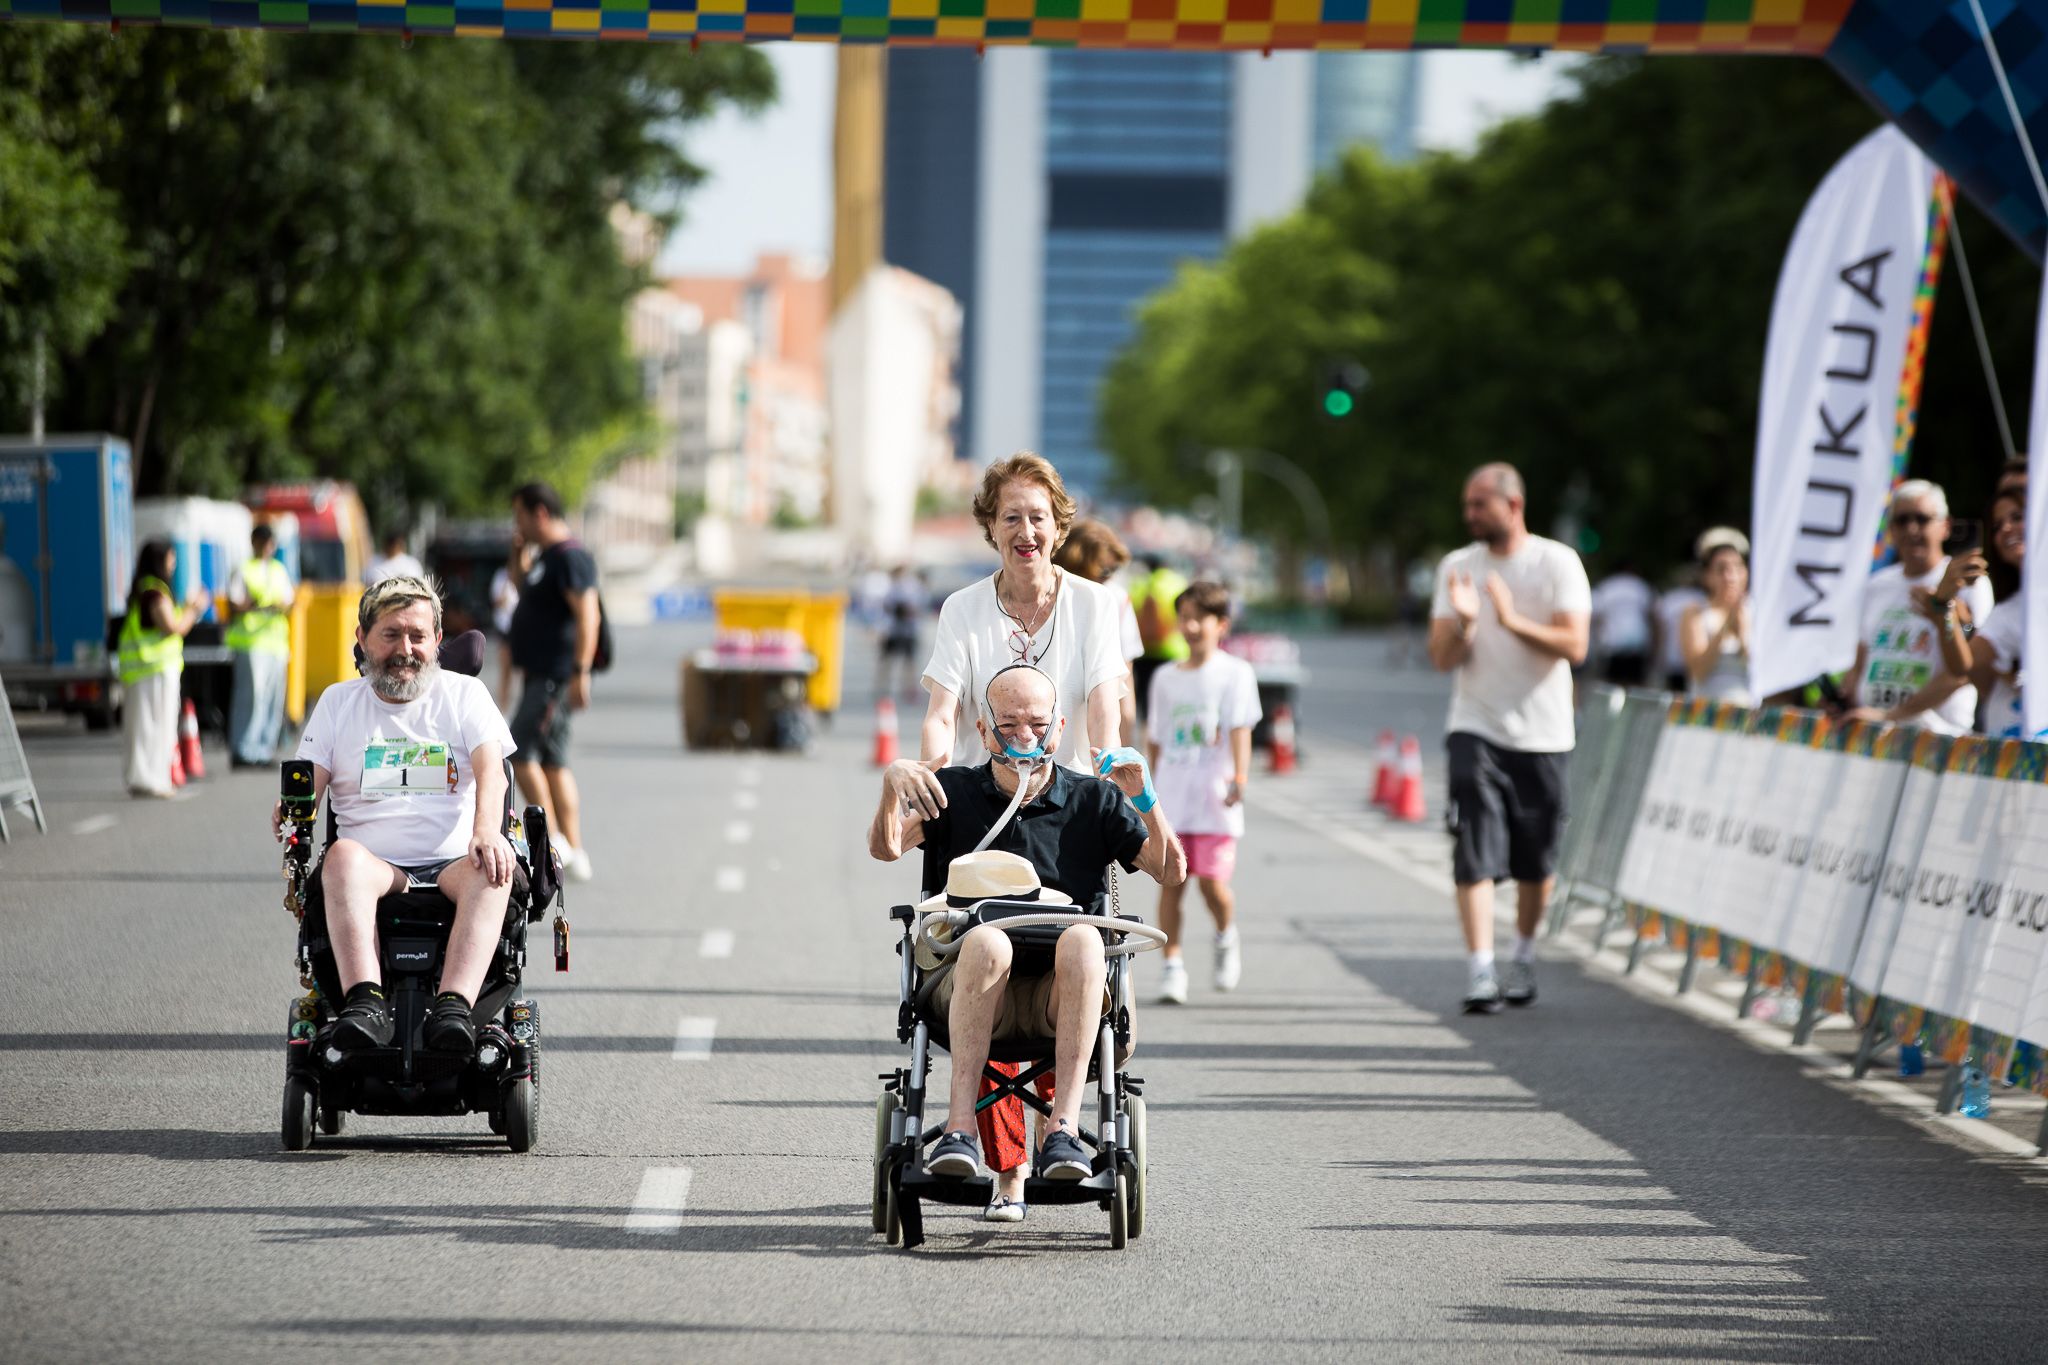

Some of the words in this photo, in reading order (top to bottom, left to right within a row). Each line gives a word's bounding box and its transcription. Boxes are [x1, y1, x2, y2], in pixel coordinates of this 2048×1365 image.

[1788, 247, 1895, 629] MUKUA
[400, 768, 409, 787] 1
[396, 952, 428, 960] permobil
